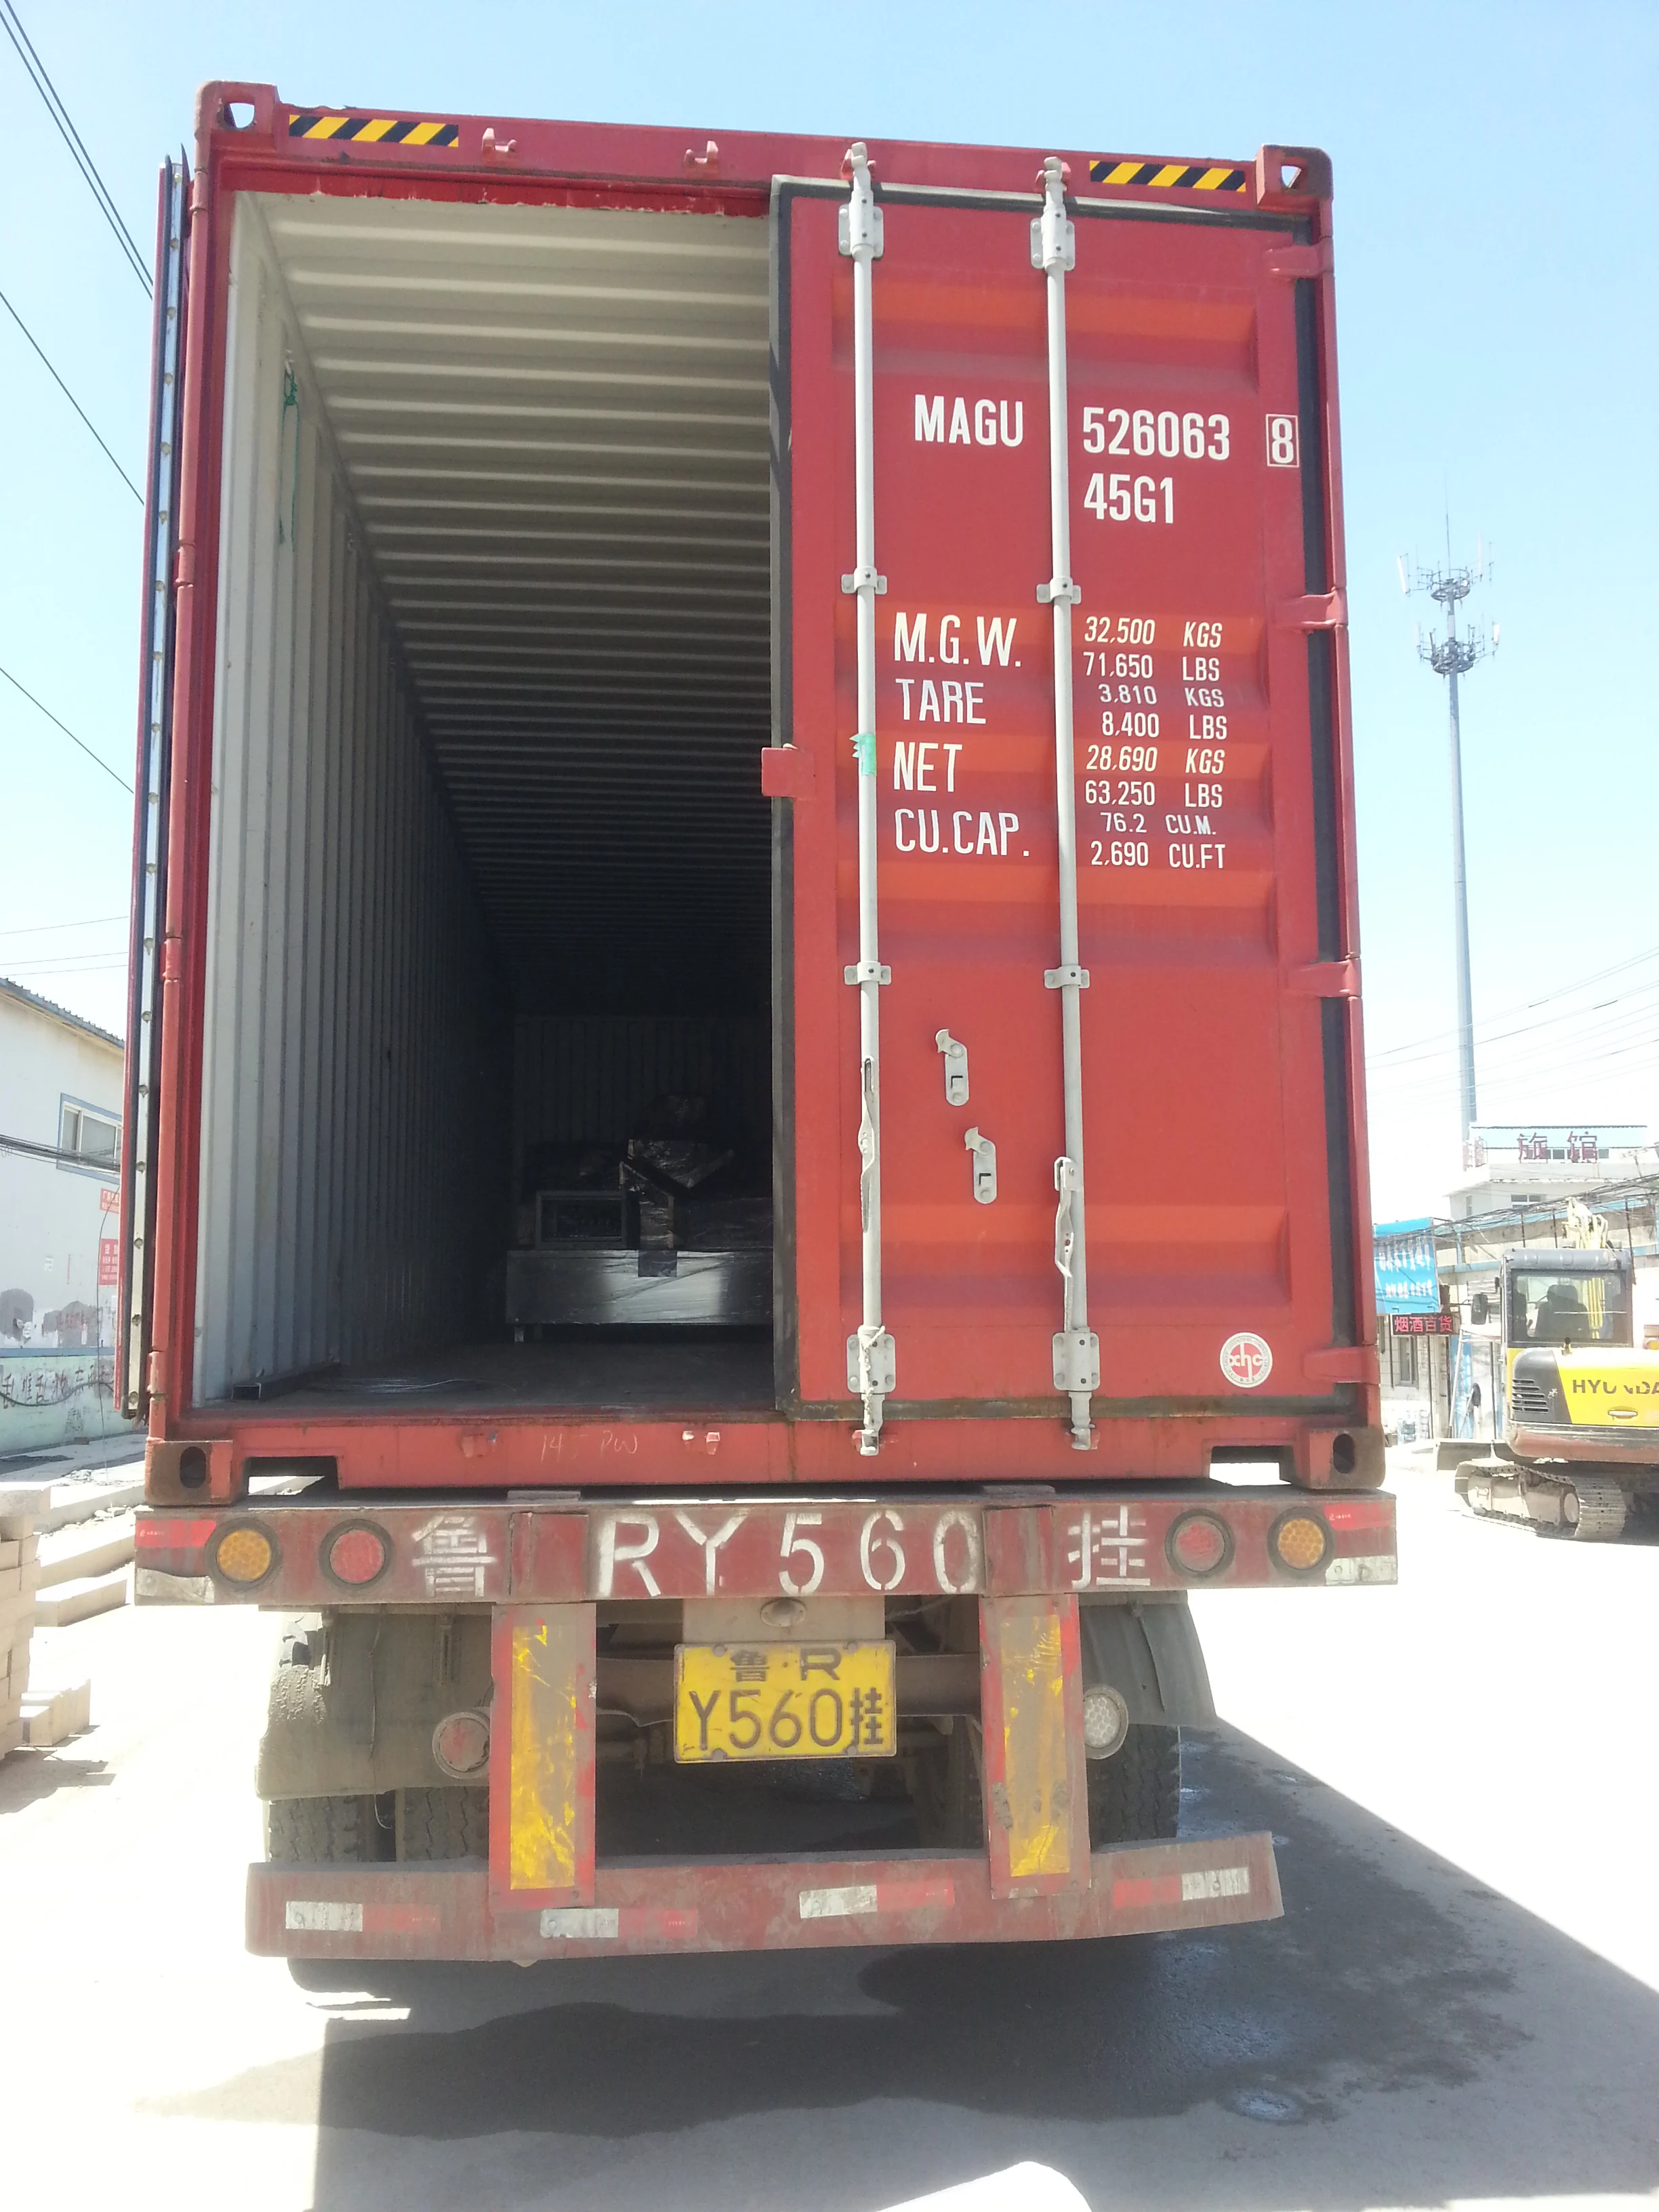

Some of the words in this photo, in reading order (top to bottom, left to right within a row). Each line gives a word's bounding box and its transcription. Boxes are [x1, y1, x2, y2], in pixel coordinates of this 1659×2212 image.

[914, 394, 1024, 447] MAGU
[1083, 406, 1231, 461] 526063
[1271, 417, 1295, 464] 8
[1084, 472, 1174, 524] 45G1
[894, 612, 1022, 668] M.G.W.
[1084, 616, 1155, 645] 32,500
[1183, 621, 1223, 648] KGS
[1083, 651, 1153, 679] 71,650
[1182, 656, 1220, 682] LBS
[895, 678, 987, 724] TARE
[1098, 684, 1158, 705] 3,810
[1185, 687, 1225, 708] KGS
[1102, 711, 1160, 738] 8,400
[1189, 714, 1227, 740] LBS
[894, 741, 963, 792] NET
[1086, 744, 1158, 772] 28,690
[1185, 748, 1225, 775] KGS
[1085, 779, 1156, 806] 63,250
[1185, 783, 1223, 808] LBS
[895, 808, 1030, 857] CU.CAP.
[1100, 812, 1147, 834] 76.2
[1090, 840, 1149, 867] 2,690
[1168, 843, 1226, 869] CU.FT
[1517, 1130, 1598, 1162] 旅馆
[1394, 1315, 1453, 1333] 烟酒百货
[411, 1515, 497, 1597] 鲁
[1067, 1504, 1150, 1590] 挂
[730, 1650, 770, 1683] 鲁
[799, 1647, 844, 1681] R
[688, 1686, 884, 1752] Y560挂
